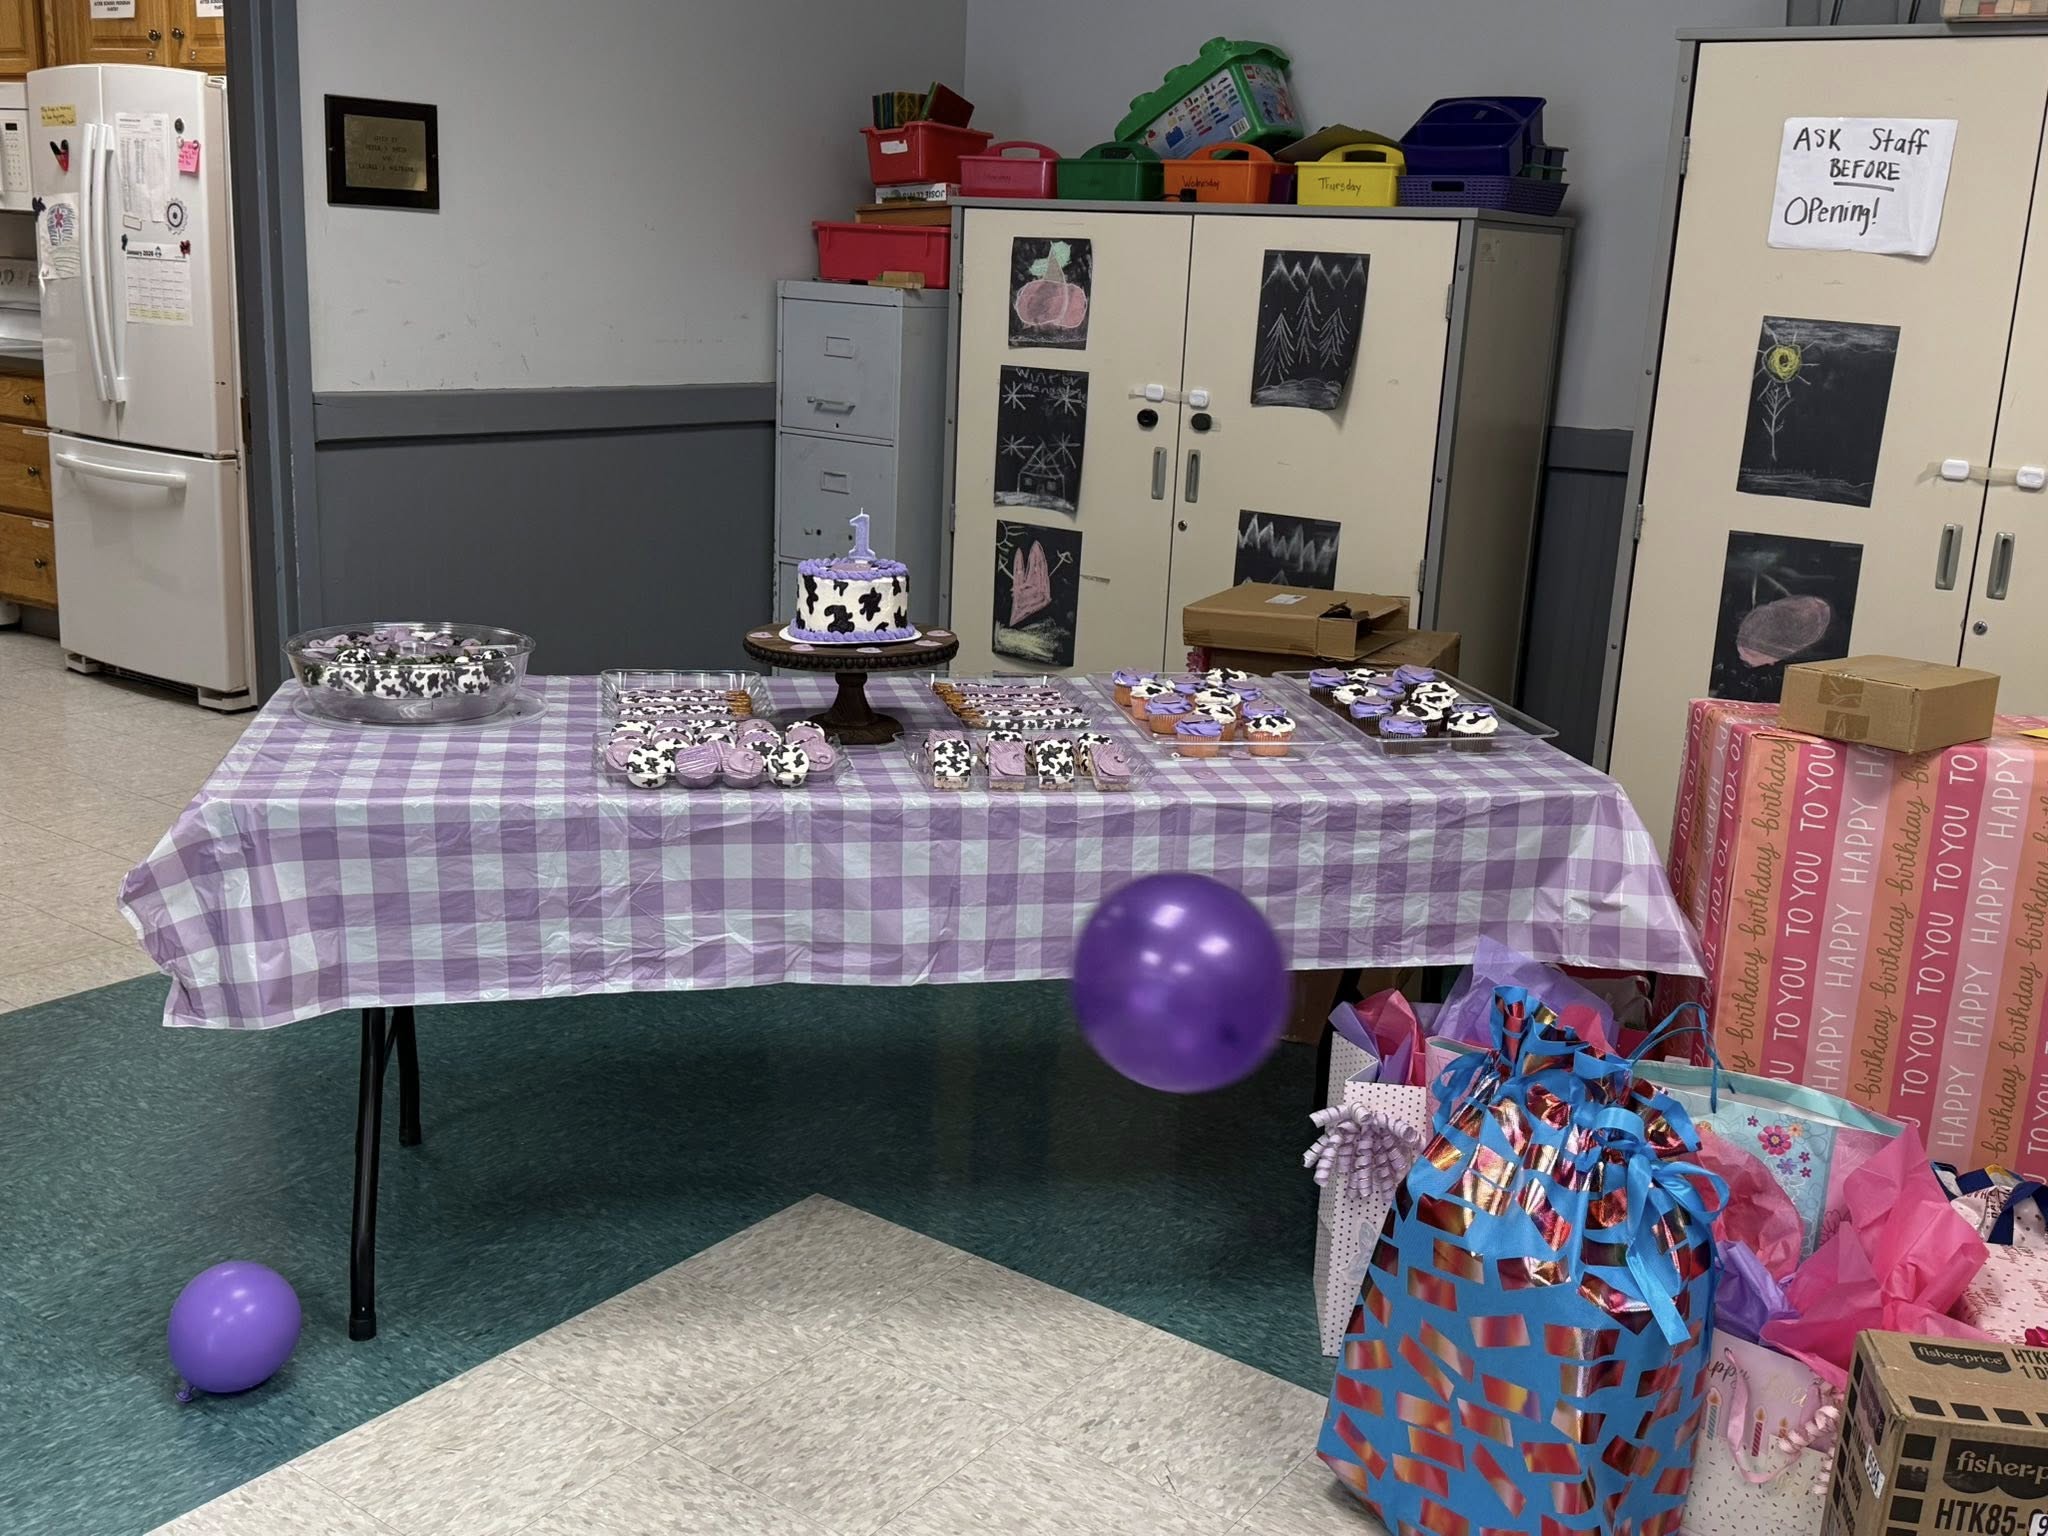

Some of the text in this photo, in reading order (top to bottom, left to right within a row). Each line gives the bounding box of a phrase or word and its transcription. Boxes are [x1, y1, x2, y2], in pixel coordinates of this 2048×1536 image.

[1793, 127, 1930, 156] ASK Staff
[1317, 176, 1362, 197] Thursday
[1830, 158, 1901, 181] BEFORE
[1729, 732, 1743, 761] TO
[1804, 743, 1837, 796] YOU
[1949, 754, 1978, 785] TO
[1687, 758, 1697, 786] TO
[1722, 769, 1738, 820] YOU
[1751, 739, 1795, 836] birthday
[1986, 748, 2025, 839] HAPPY
[1678, 793, 1693, 840] YOU
[1704, 776, 1721, 863] HAPPY
[1799, 802, 1829, 831] TO
[1840, 797, 1879, 884] HAPPY
[1938, 804, 1970, 856] YOU
[1717, 838, 1729, 867] TO
[1885, 795, 1931, 896] birthday
[1673, 857, 1683, 884] TO
[1738, 842, 1781, 942] birthday
[1789, 851, 1822, 901] YOU
[1933, 862, 1962, 892] TO
[1710, 875, 1724, 924] YOU
[1785, 907, 1814, 937] TO
[1970, 857, 2009, 944] HAPPY
[1705, 941, 1717, 971] TO
[1824, 903, 1863, 988] HAPPY
[1869, 902, 1914, 1000] birthday
[1921, 911, 1954, 960] YOU
[1726, 947, 1767, 1045] birthday
[1776, 956, 1807, 1006] YOU
[1916, 967, 1945, 995] TO
[1953, 963, 1993, 1047] HAPPY
[1773, 1012, 1801, 1041] TO
[1998, 961, 2044, 1060] birthday
[1811, 1006, 1847, 1090] HAPPY
[1854, 1004, 1898, 1101] birthday
[1905, 1014, 1937, 1063] YOU
[1900, 1068, 1930, 1097] TO
[1937, 1064, 1976, 1147] HAPPY
[1980, 1063, 2027, 1159] birthday
[1917, 1346, 2004, 1366] fisher-price
[2019, 1365, 2031, 1379] 1
[1956, 1450, 2048, 1485] fisher-p
